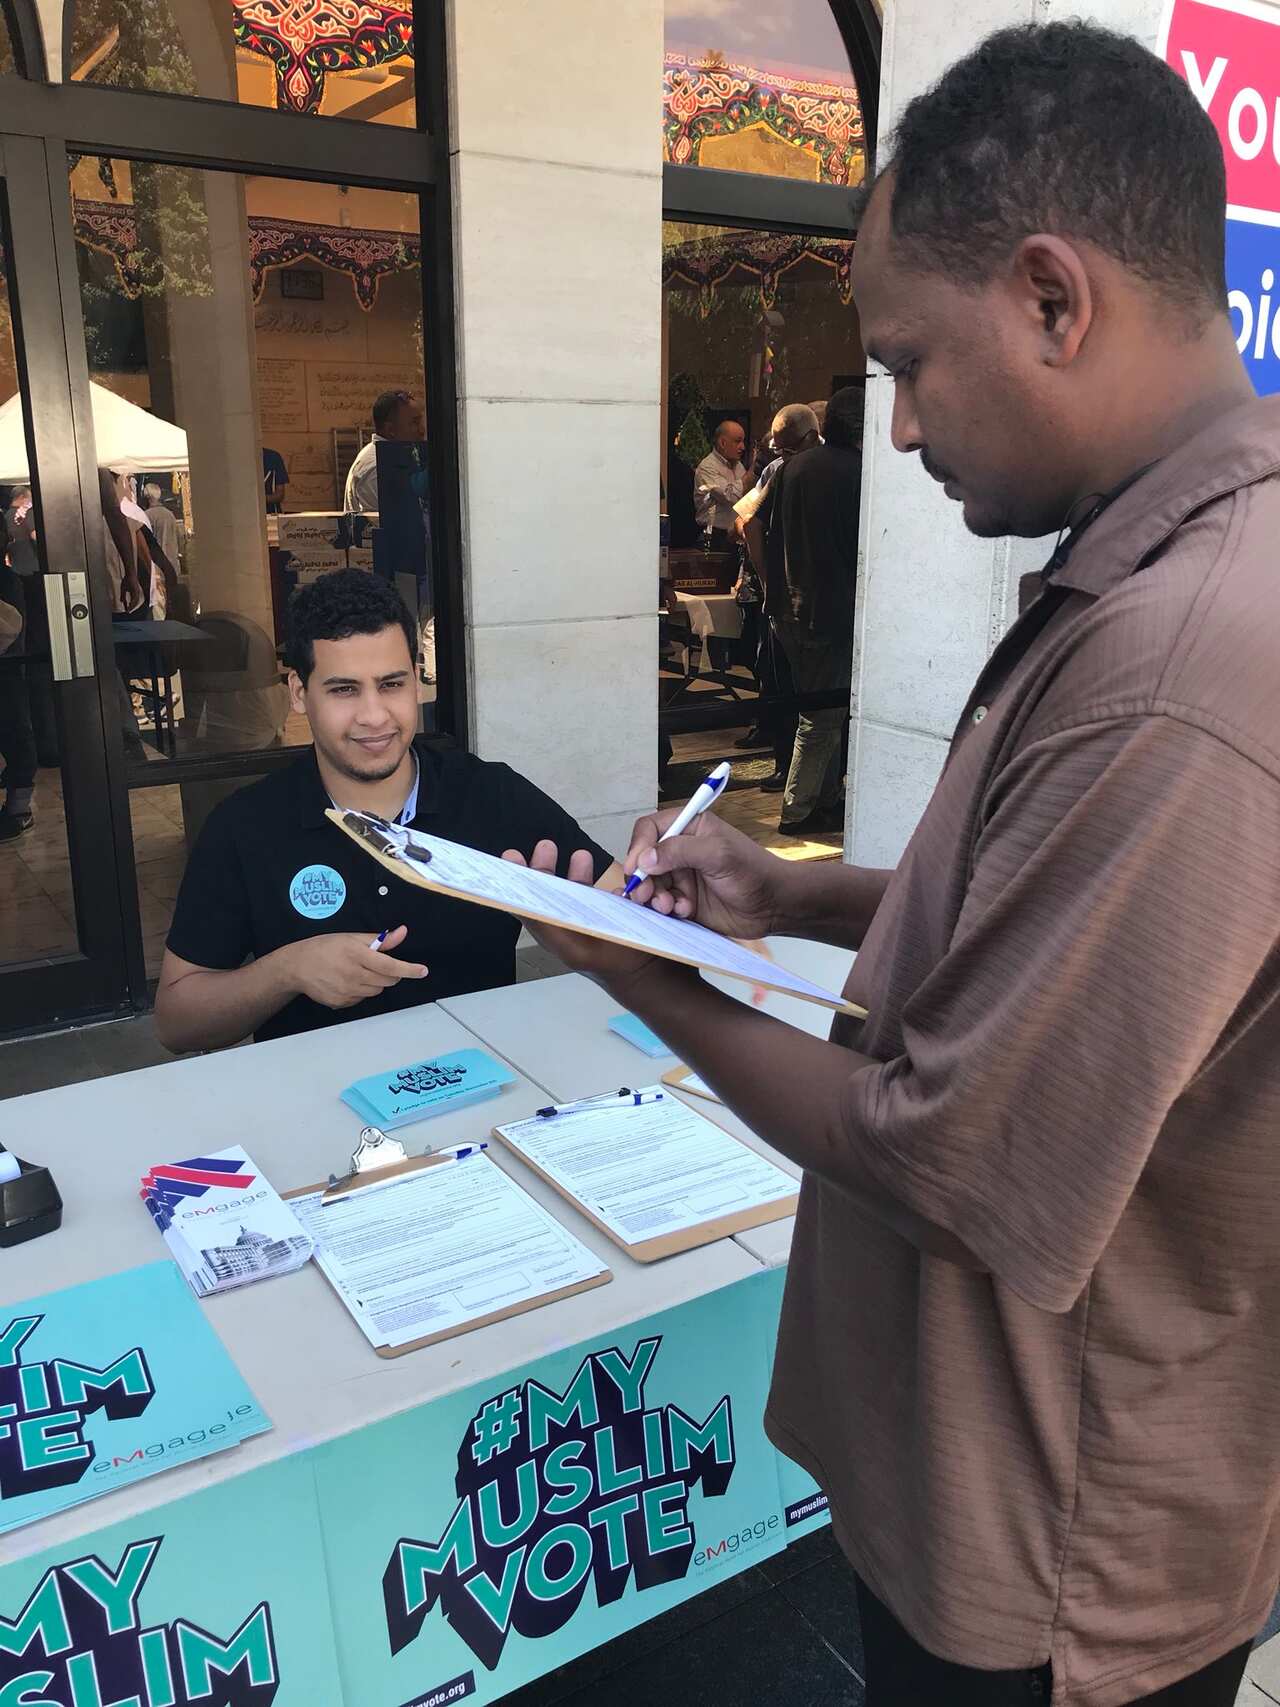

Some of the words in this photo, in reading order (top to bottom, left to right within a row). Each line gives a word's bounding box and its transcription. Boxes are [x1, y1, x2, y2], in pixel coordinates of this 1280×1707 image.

[1180, 50, 1280, 167] Yo
[301, 891, 337, 907] VOTE
[405, 1074, 463, 1094] VOTE
[182, 1191, 268, 1219] eMgage
[471, 1338, 659, 1467] #MY
[93, 1423, 207, 1473] eMgage
[399, 1398, 733, 1617] MUSLIM
[463, 1480, 693, 1634] VOTE
[693, 1514, 779, 1567] eMgage
